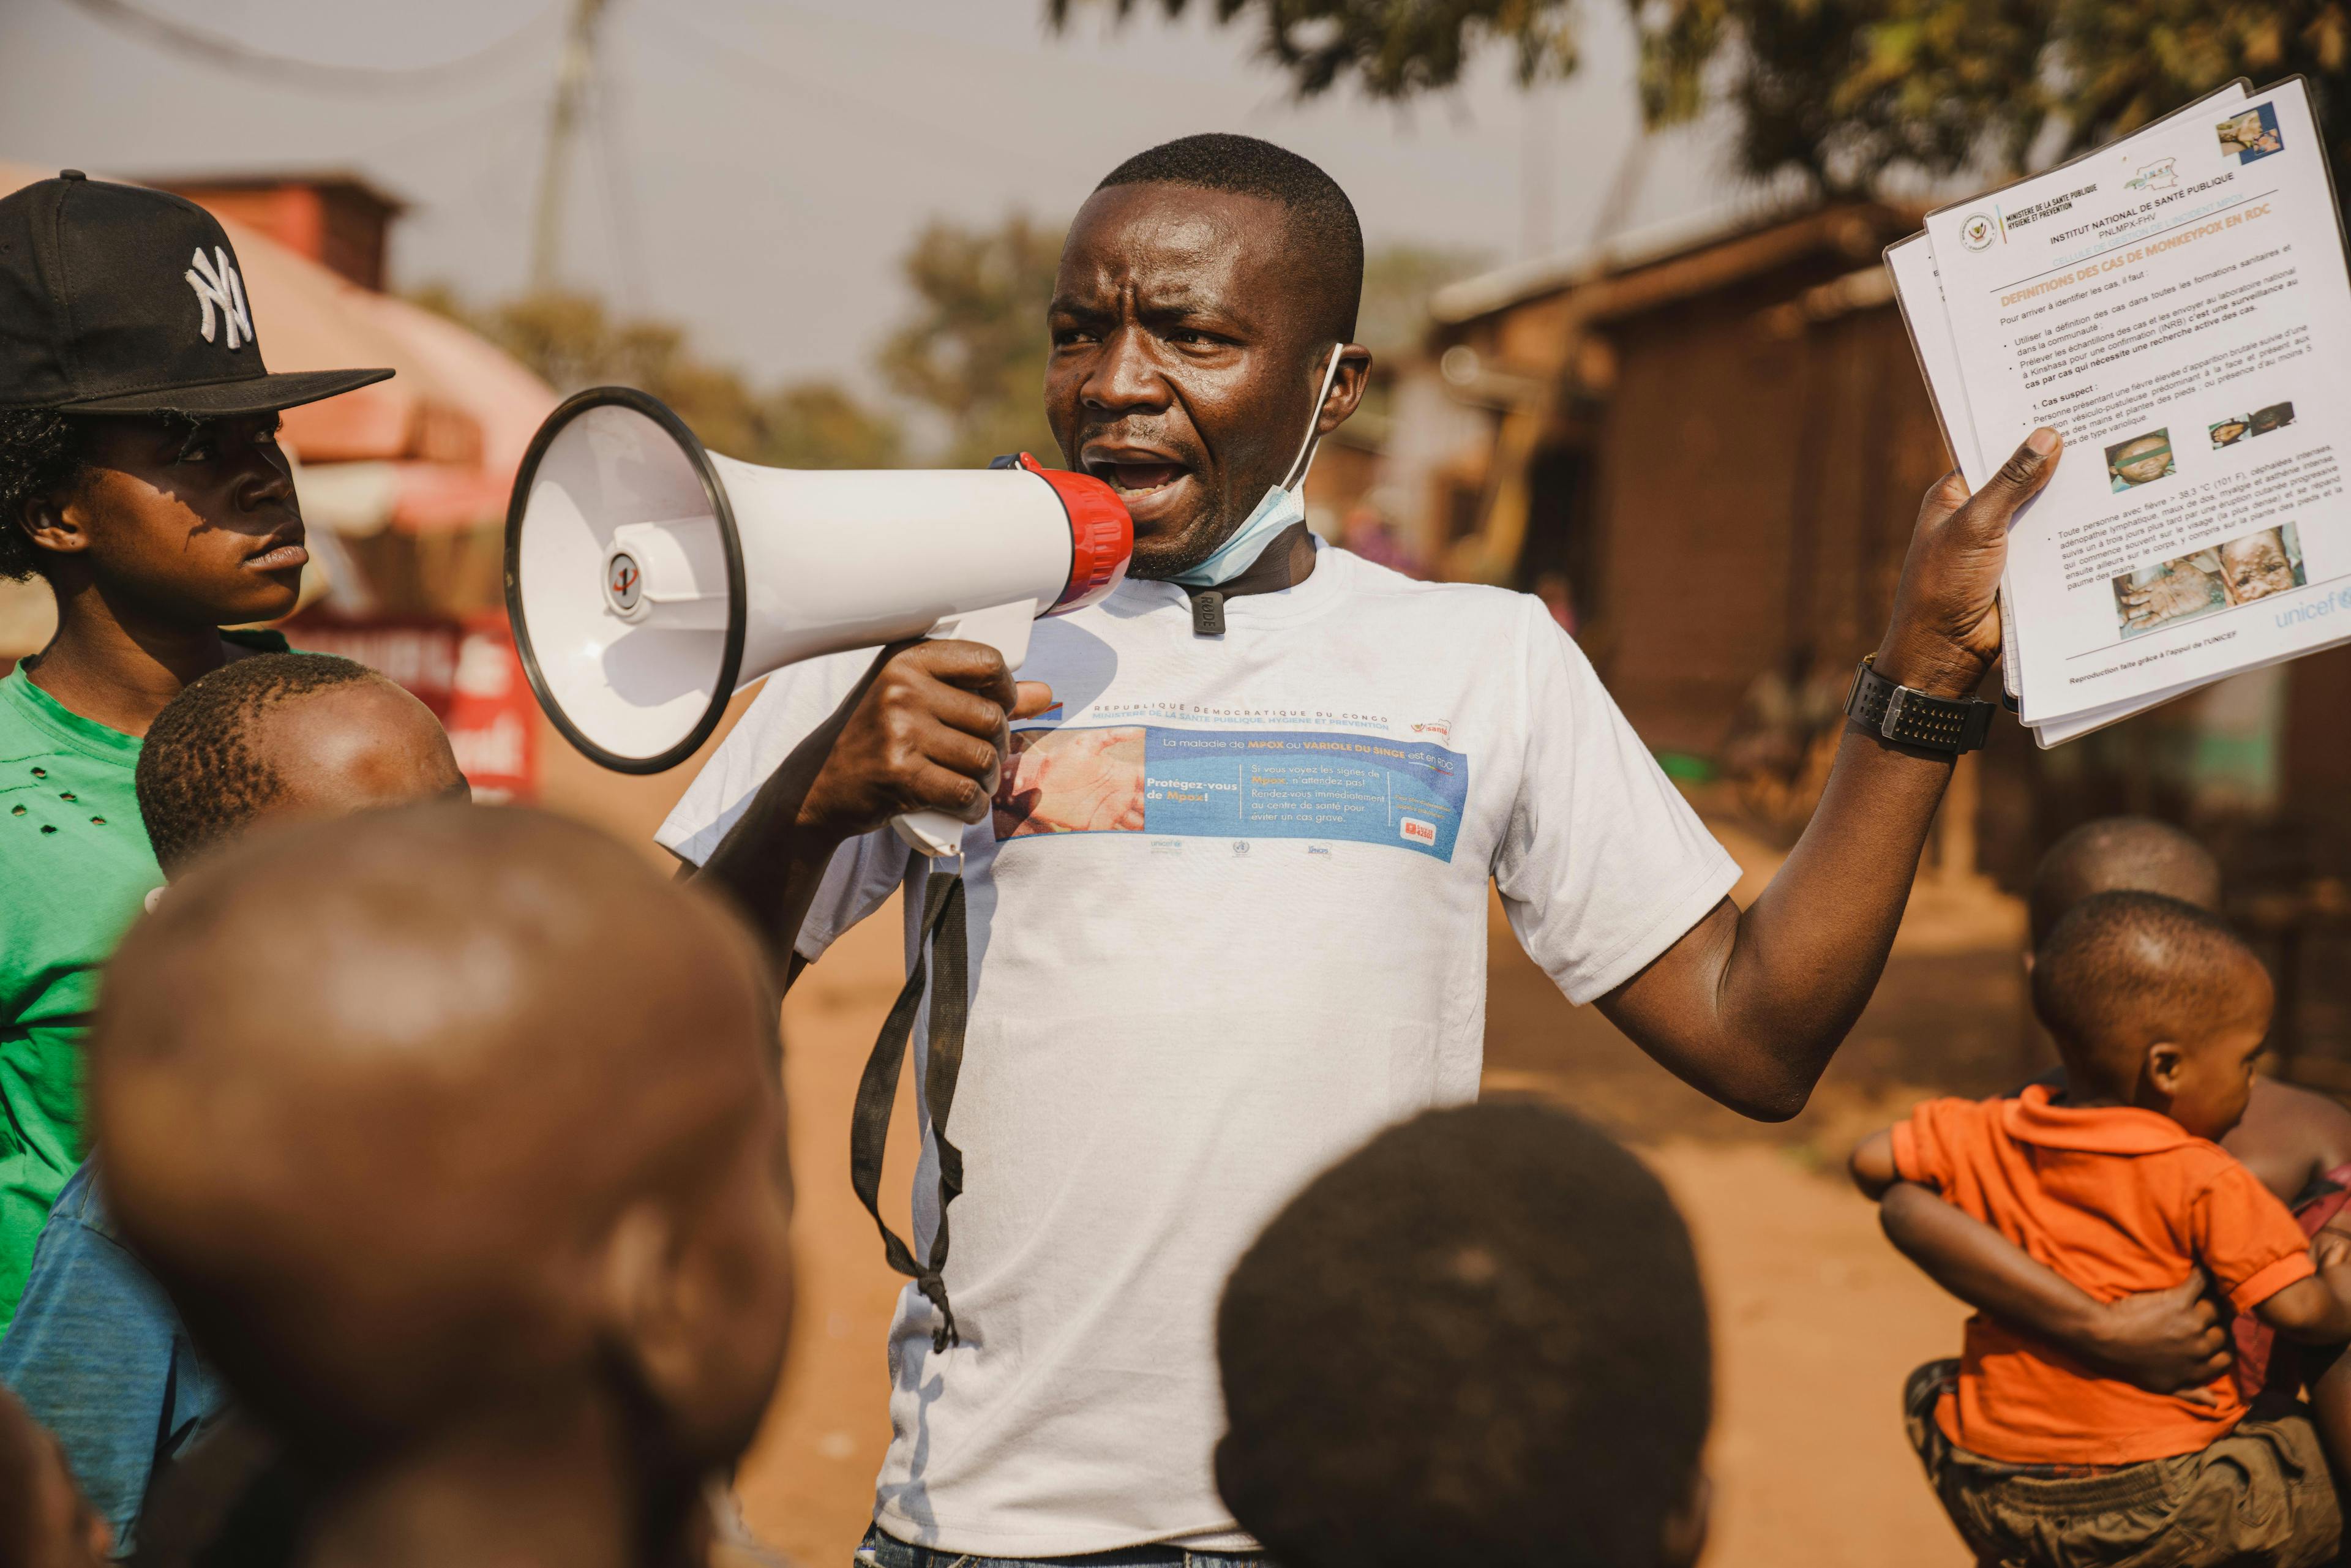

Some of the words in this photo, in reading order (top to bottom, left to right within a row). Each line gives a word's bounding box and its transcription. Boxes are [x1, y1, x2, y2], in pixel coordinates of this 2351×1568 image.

[2005, 205, 2035, 222] MINISTERE
[2034, 203, 2043, 212] DE
[2042, 200, 2052, 209] LA
[2051, 193, 2070, 206] SANTE
[2069, 183, 2098, 200] PUBLIQUE
[2007, 215, 2031, 230] HYGIENE
[2030, 212, 2038, 222] ET
[2038, 200, 2072, 219] PREVENTION
[2050, 223, 2090, 244] INSTITUT
[2091, 208, 2138, 230] NATIONAL
[2139, 201, 2153, 212] DE
[2154, 189, 2185, 207] SANTÉ
[2186, 171, 2234, 195] PUBLIQUE
[2098, 212, 2156, 239] PNLMPX-FHV
[2000, 273, 2074, 307] DEFINITIONS
[2075, 264, 2099, 280] DES
[2101, 255, 2124, 272] CAS
[2126, 249, 2143, 263] DE
[2145, 220, 2224, 257] MONKEYPOX
[2224, 213, 2242, 228] EN
[2244, 203, 2271, 221] RDC
[2000, 314, 2019, 326] Pour
[2020, 306, 2046, 319] arriver
[2054, 290, 2088, 307] identifier
[2089, 286, 2102, 295] les
[2128, 271, 2145, 282] faut
[2014, 332, 2041, 346] Utiliser
[2054, 315, 2091, 332] définition
[2093, 309, 2109, 319] des
[2110, 303, 2126, 313] cas
[2128, 295, 2149, 307] dans
[2150, 285, 2177, 299] toutes
[2178, 280, 2192, 289] les
[2193, 264, 2237, 284] formations
[2239, 249, 2280, 268] sanitaires
[2282, 243, 2292, 252] et
[2019, 352, 2053, 369] Prélever
[2053, 348, 2067, 357] les
[2068, 332, 2115, 353] échantillons
[2115, 326, 2131, 336] des
[2132, 321, 2147, 330] cas
[2148, 316, 2158, 324] et
[2158, 312, 2170, 321] les
[2171, 300, 2204, 317] envoyer
[2217, 280, 2262, 300] laboratoire
[2263, 266, 2296, 283] national
[2030, 359, 2067, 377] Kinshasa
[2069, 352, 2087, 365] pour
[2090, 347, 2105, 356] une
[2107, 329, 2156, 350] confirmation
[2158, 317, 2186, 334] (INRB)
[2211, 303, 2229, 313] une
[2230, 283, 2284, 307] surveillance
[2286, 278, 2298, 287] au
[2016, 345, 2037, 356] dans
[2046, 323, 2098, 346] communauté
[2024, 380, 2041, 389] cas
[2041, 373, 2056, 385] par
[2057, 369, 2073, 378] cas
[2074, 361, 2088, 373] qui
[2090, 349, 2131, 367] nécessite
[2131, 343, 2148, 353] une
[2149, 327, 2192, 347] recherche
[2194, 317, 2220, 331] active
[2221, 311, 2237, 321] des
[2033, 407, 2072, 424] Personne
[2072, 391, 2114, 413] présentant
[2115, 387, 2130, 397] une
[2131, 379, 2153, 391] fièvre
[2154, 369, 2181, 383] élevée
[2229, 342, 2258, 356] brutale
[2258, 333, 2283, 346] suivie
[2041, 397, 2058, 407] Cas
[2059, 384, 2094, 402] suspect
[1201, 596, 1216, 628] RØDE
[2276, 594, 2336, 629] unicef
[2069, 666, 2119, 685] Reproduction
[2119, 661, 2136, 670] faite
[2137, 655, 2158, 666] grâce
[1092, 710, 1146, 718] MINISTERE
[1179, 713, 1210, 722] SANTE
[1330, 719, 1389, 730] PREVENTION
[1194, 706, 1306, 716] DEMOCRATIQUE
[1343, 713, 1387, 722] CONGO
[1427, 727, 1447, 735] santé
[1303, 741, 1352, 751] VARIOLE
[1355, 744, 1370, 754] DU
[1373, 746, 1405, 759] SINGE
[1426, 754, 1436, 763] en
[1438, 757, 1453, 770] RDC
[1147, 778, 1237, 790] Protégez-vous
[1337, 767, 1365, 776] signes
[1368, 770, 1379, 778] de
[1346, 779, 1365, 787] pas!
[1146, 790, 1163, 799] de
[1166, 790, 1208, 803] Mpox!
[1251, 789, 1311, 798] Rendez-vous
[1315, 790, 1384, 803] immédiatement
[1344, 804, 1365, 812] pour
[1251, 812, 1278, 820] éviter
